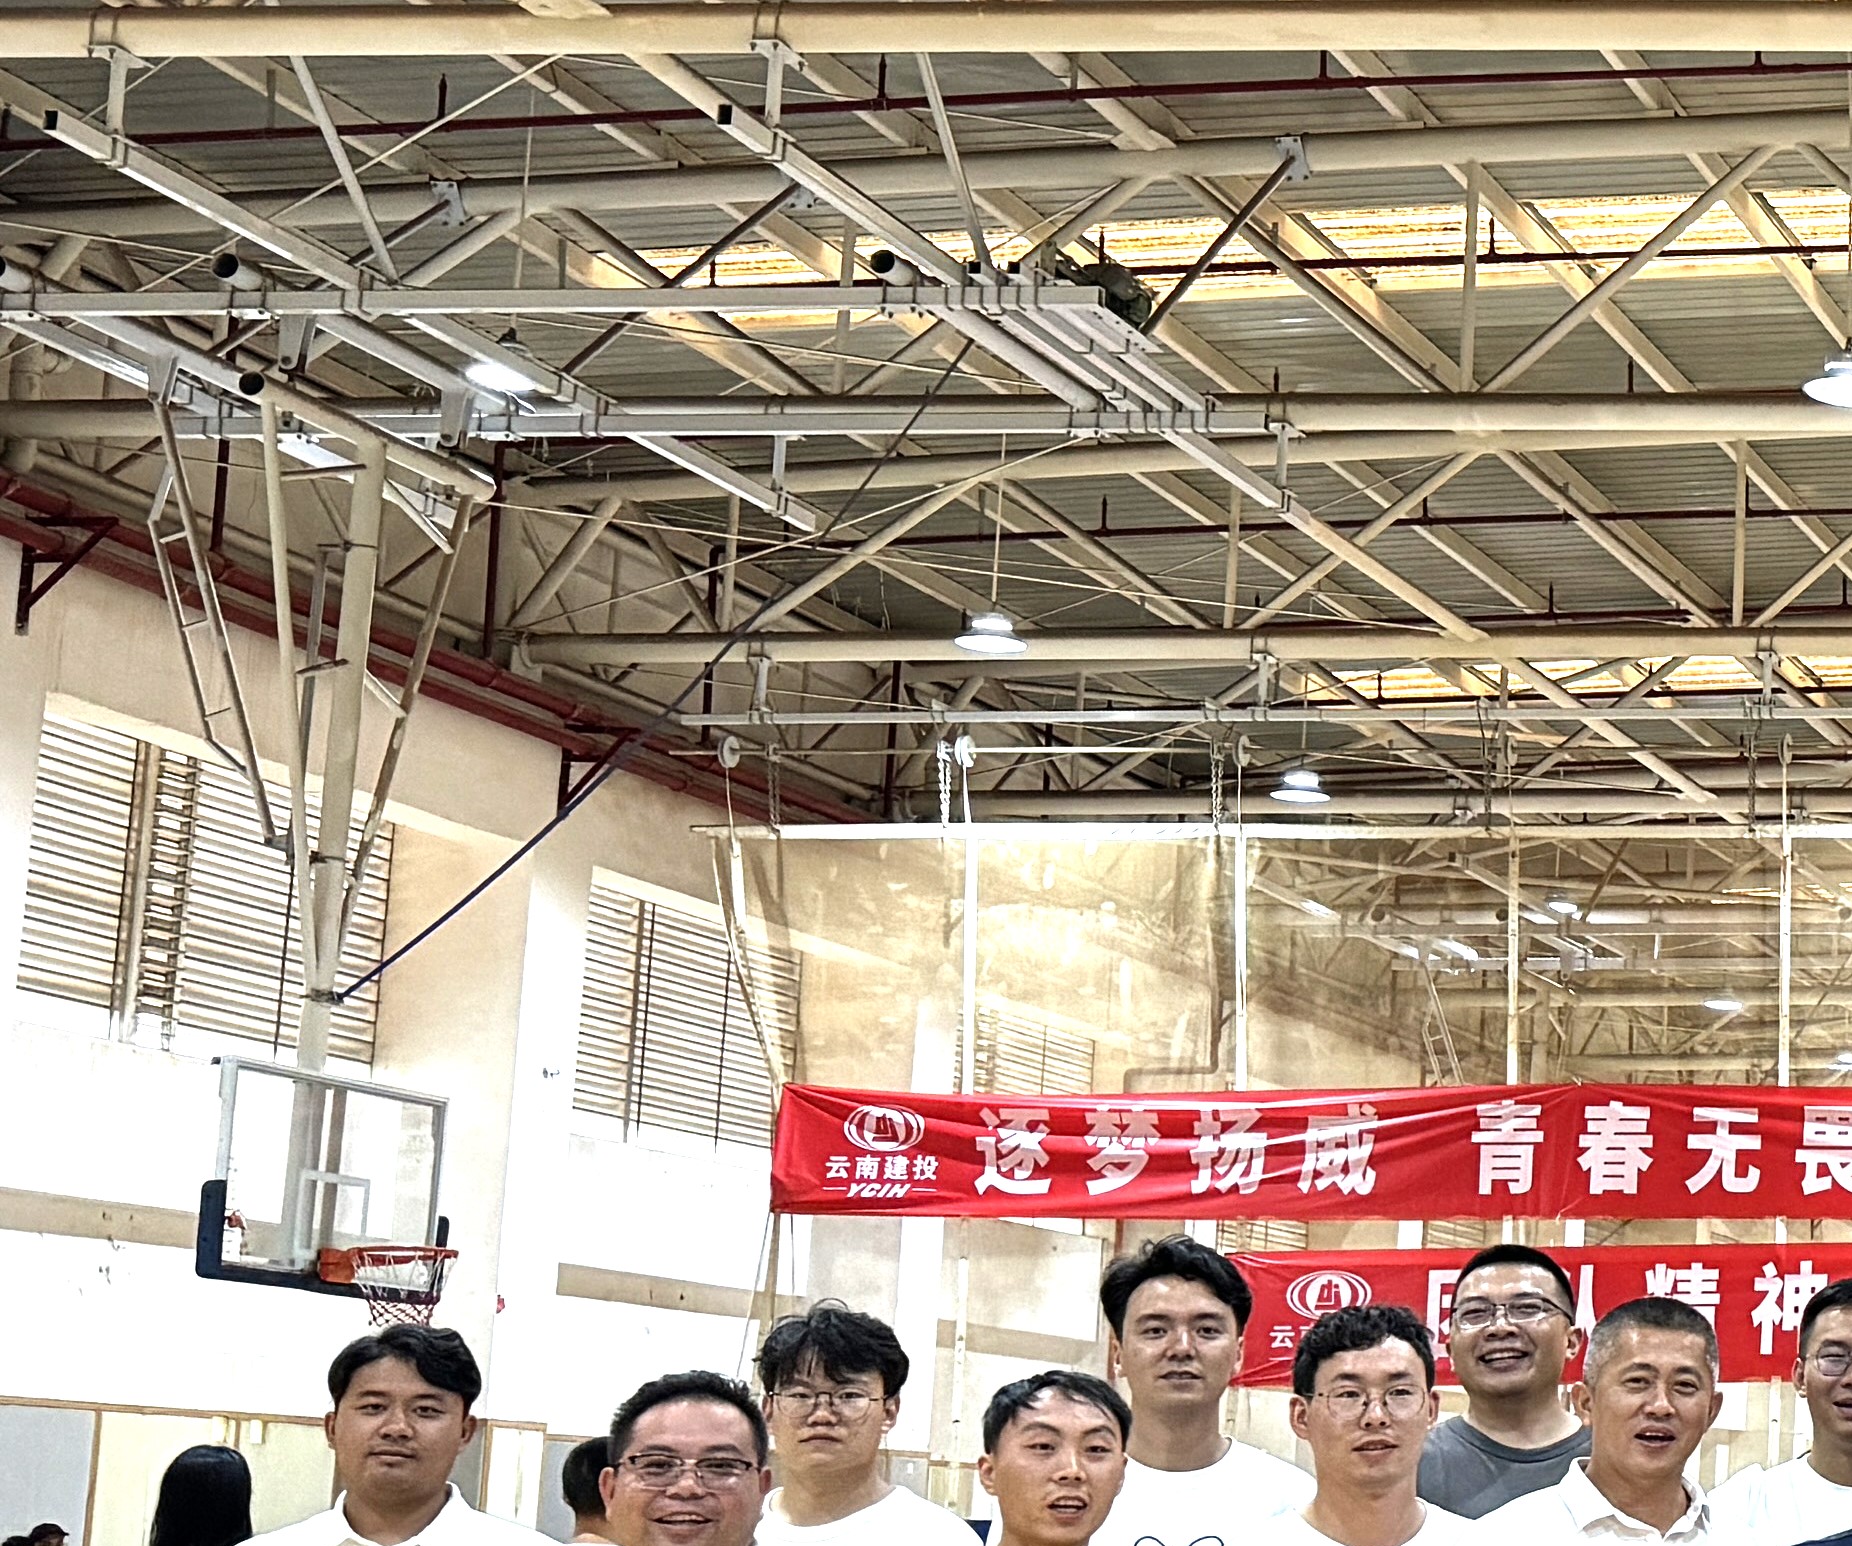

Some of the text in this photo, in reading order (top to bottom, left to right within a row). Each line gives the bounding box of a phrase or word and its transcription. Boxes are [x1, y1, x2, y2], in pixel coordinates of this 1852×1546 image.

[975, 1104, 1377, 1196] 逐梦扬威
[825, 1154, 939, 1182] 云南建投
[845, 1183, 912, 1199] YCIH
